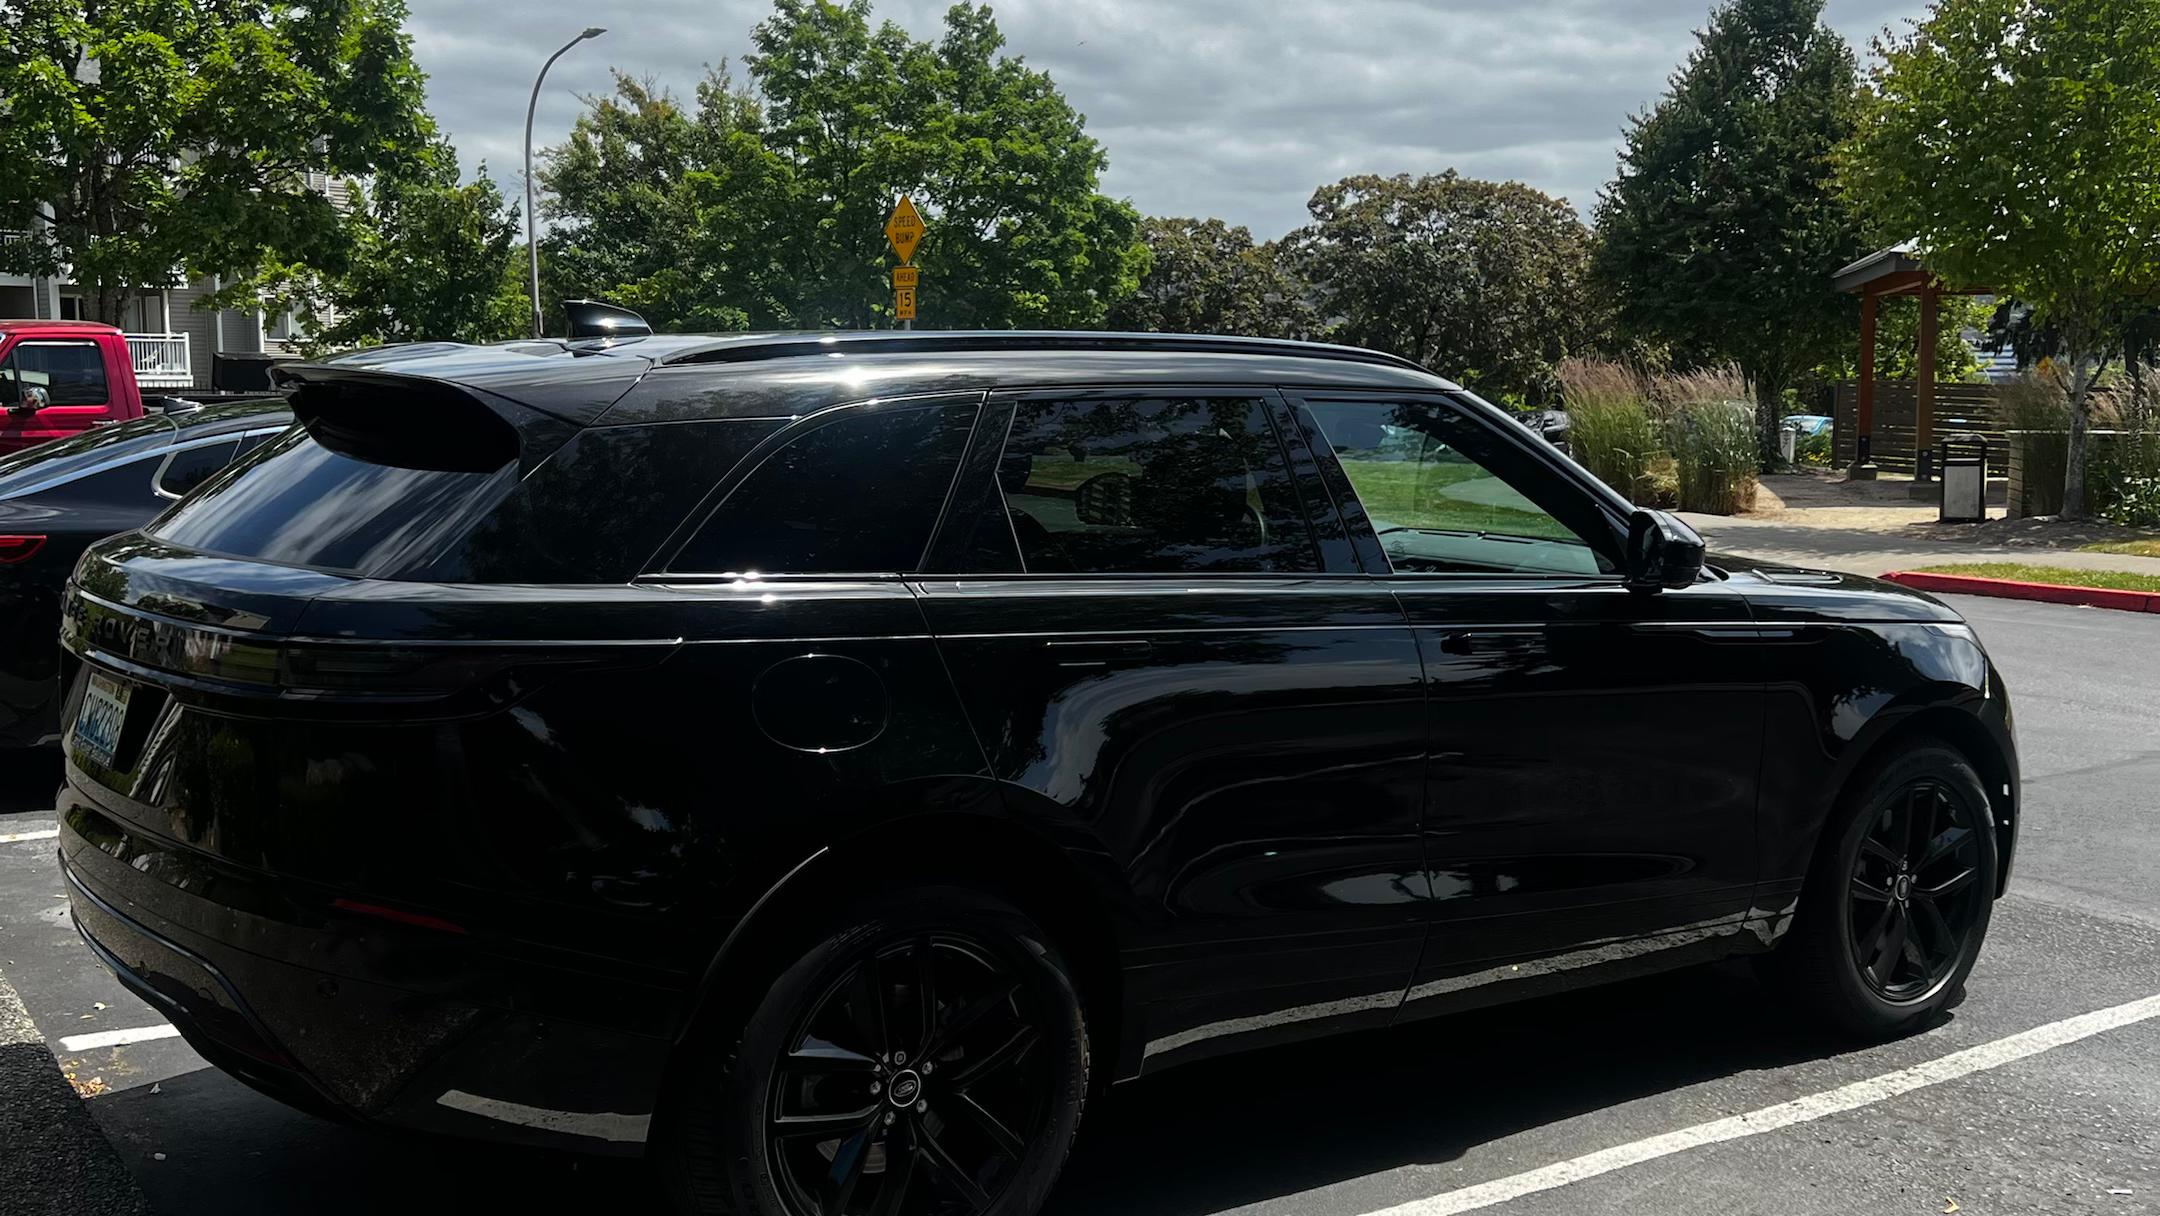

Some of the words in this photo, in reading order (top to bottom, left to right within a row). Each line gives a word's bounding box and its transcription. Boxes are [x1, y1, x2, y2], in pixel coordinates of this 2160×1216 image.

[894, 215, 915, 228] SPEED
[895, 231, 915, 244] BUMP
[896, 272, 915, 282] AHEAD
[899, 292, 912, 308] 15
[94, 614, 171, 653] ROVER
